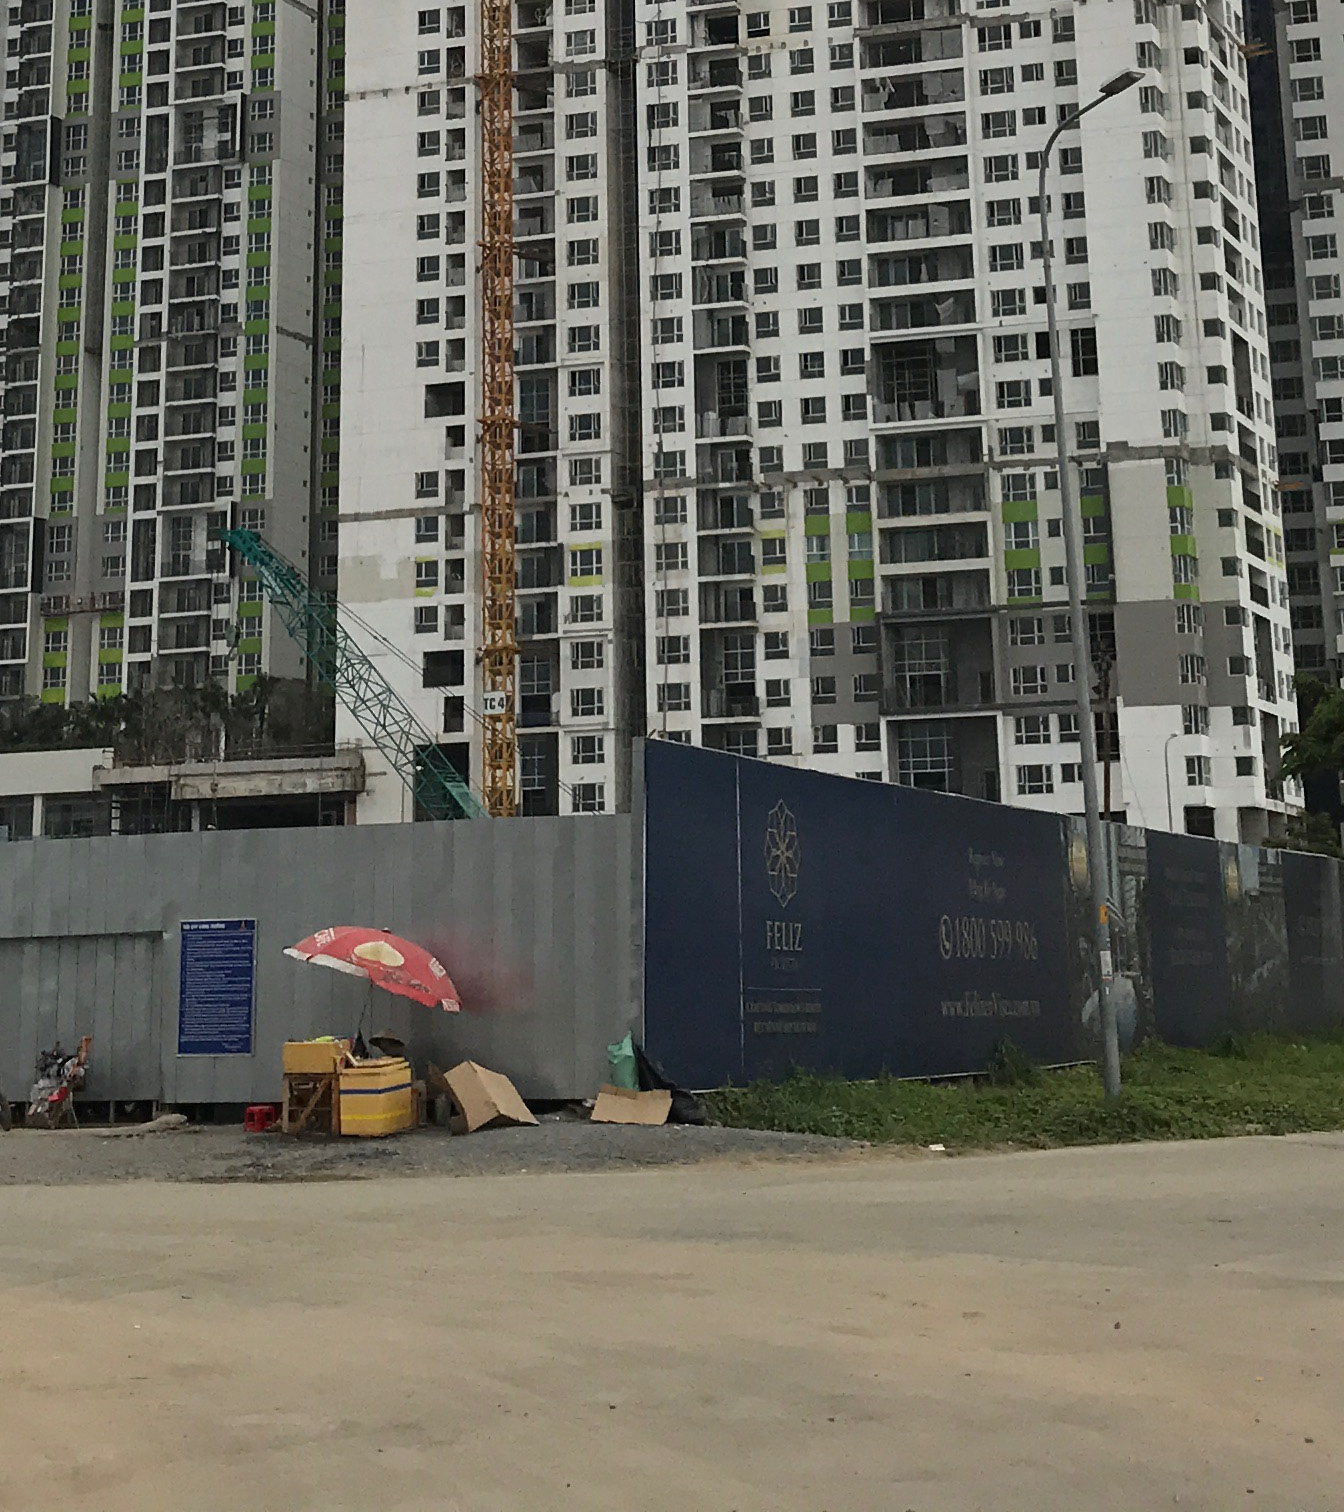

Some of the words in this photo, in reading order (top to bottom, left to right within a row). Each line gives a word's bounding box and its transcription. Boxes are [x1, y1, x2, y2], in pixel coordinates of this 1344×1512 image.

[483, 697, 496, 710] TC
[497, 697, 505, 710] 4
[765, 920, 803, 951] FELIZ
[955, 916, 986, 958] 1800
